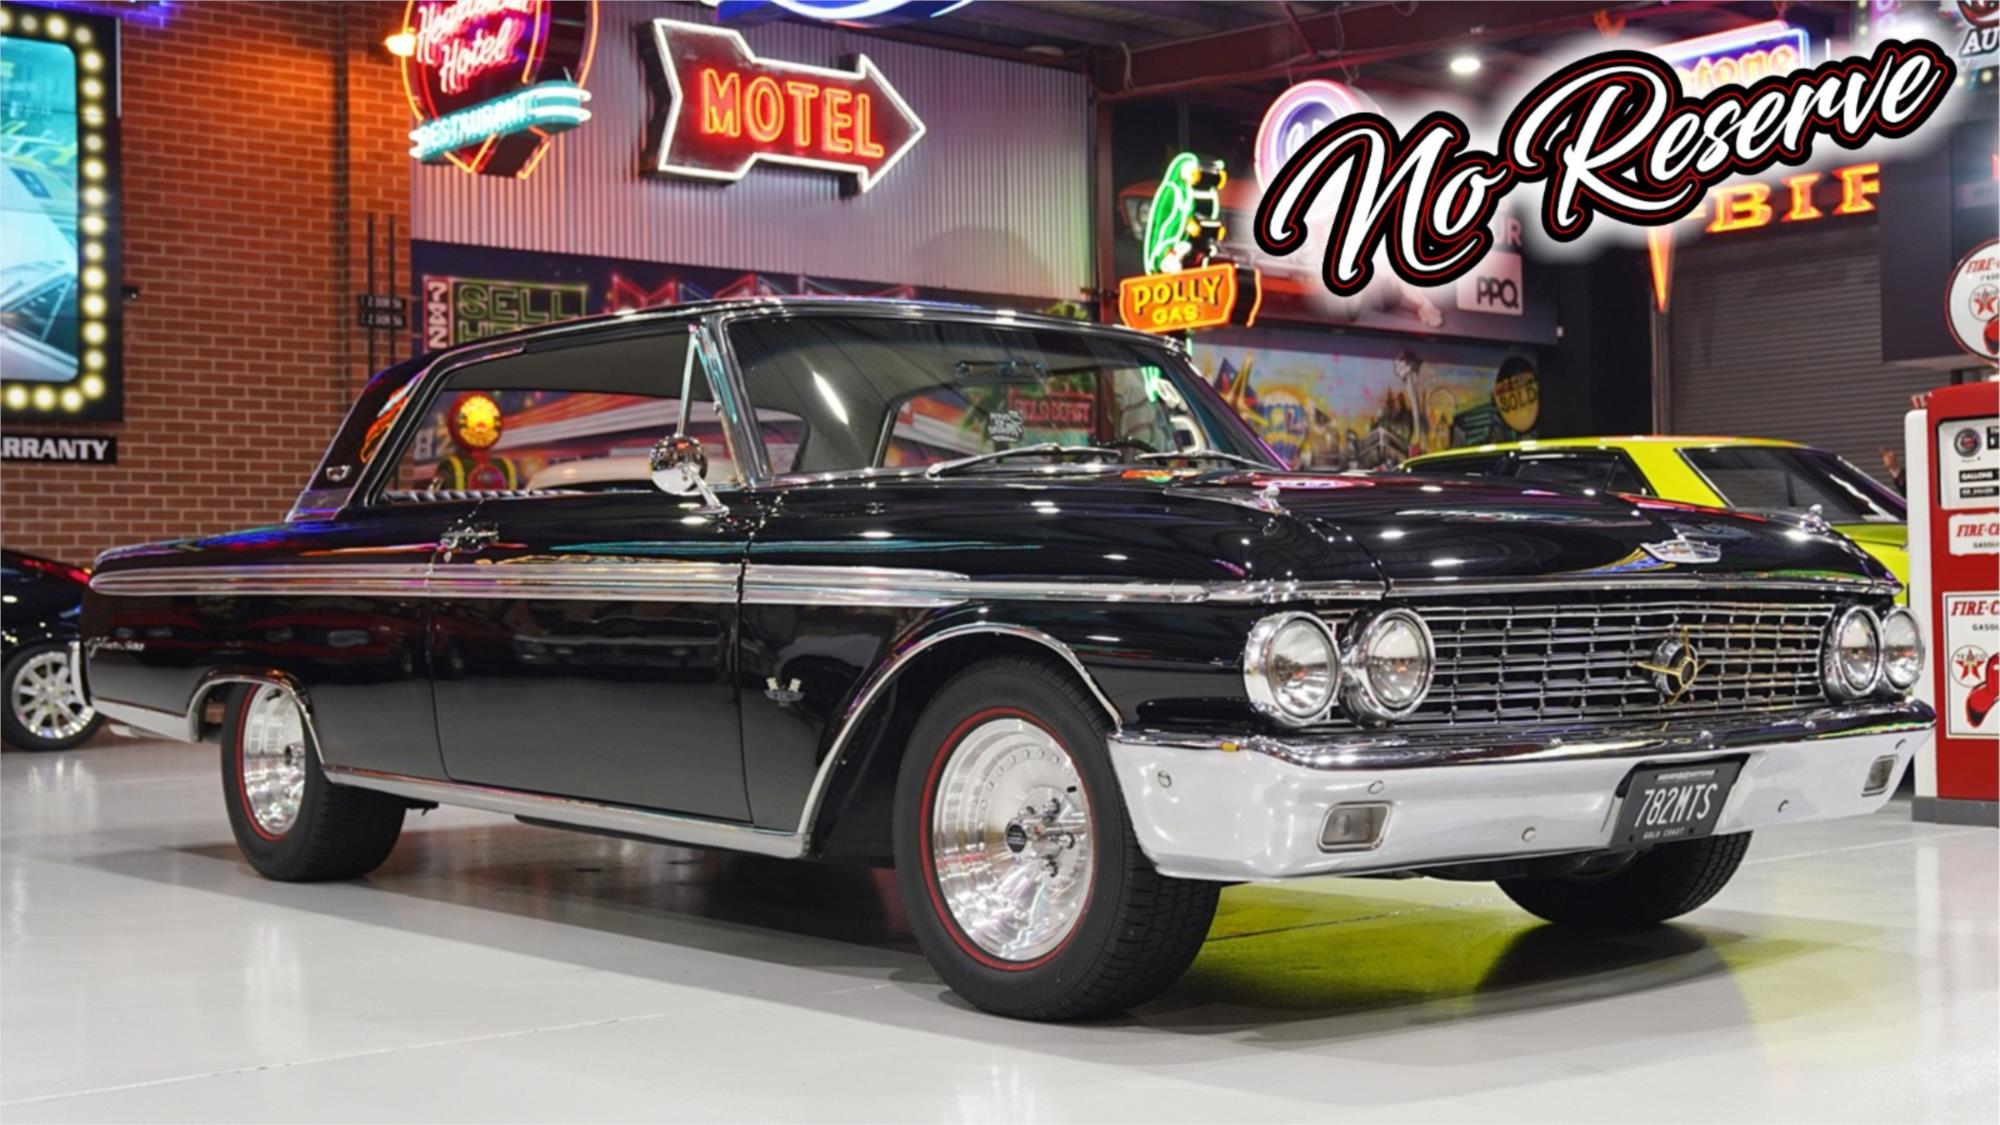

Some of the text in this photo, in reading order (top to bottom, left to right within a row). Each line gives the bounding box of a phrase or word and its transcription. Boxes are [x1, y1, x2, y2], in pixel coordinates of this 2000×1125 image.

[439, 18, 513, 93] Hotel
[701, 68, 885, 158] MOTEL
[458, 284, 576, 321] SELL
[1132, 275, 1223, 315] POLLY
[1477, 276, 1519, 310] PPQ
[1152, 304, 1198, 325] GAS
[0, 437, 108, 460] RRANTY
[1634, 783, 1718, 828] 782MTS
